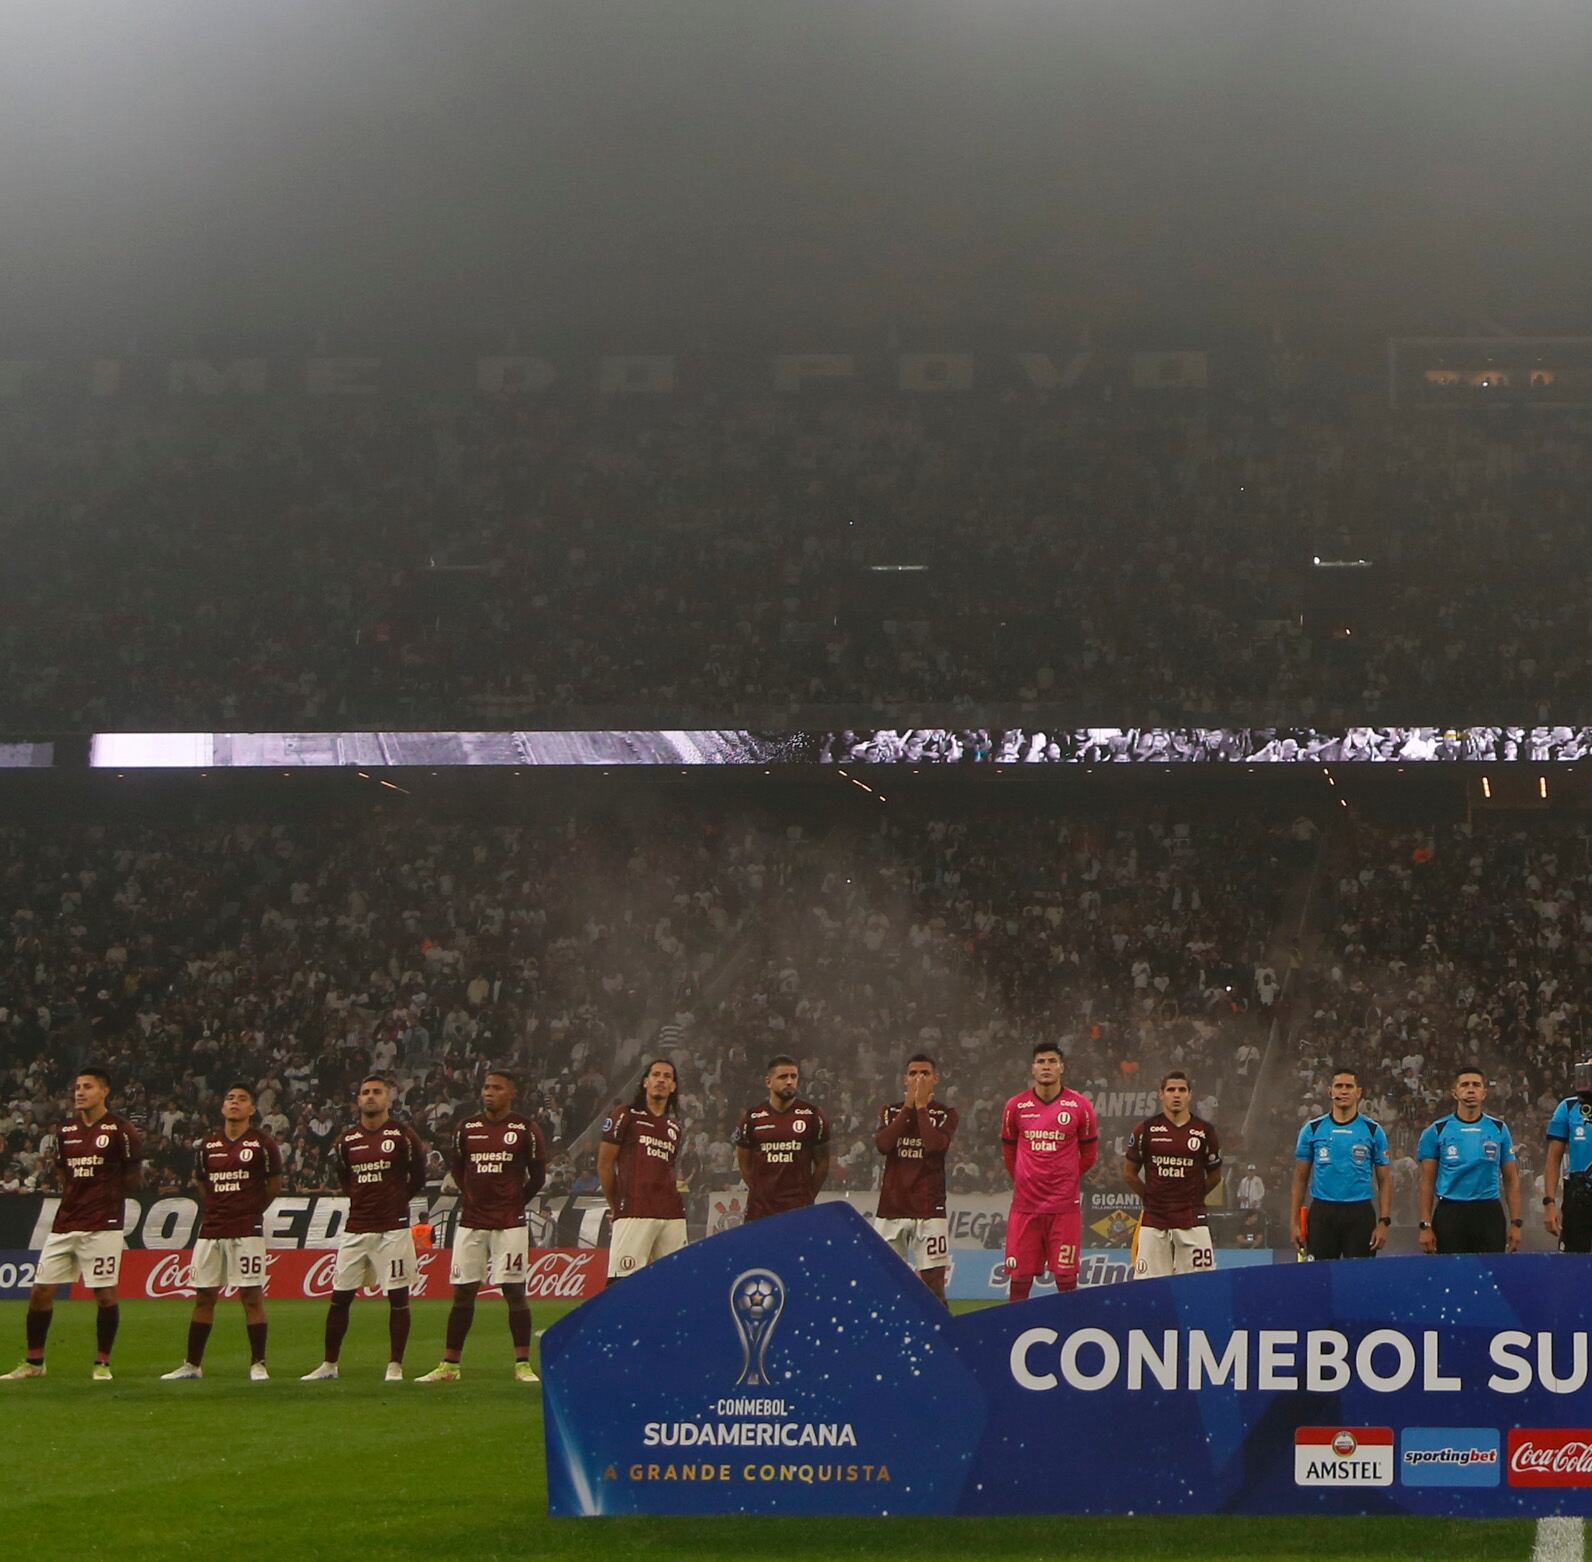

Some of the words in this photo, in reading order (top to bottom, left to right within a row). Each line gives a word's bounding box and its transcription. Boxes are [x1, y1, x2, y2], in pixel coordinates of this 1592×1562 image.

[646, 1145, 670, 1162] total
[760, 1139, 802, 1152] apuesta
[1031, 1140, 1057, 1151] total
[470, 1151, 513, 1164] apuesta
[767, 1152, 794, 1163] total
[1152, 1155, 1194, 1168] apuesta
[477, 1163, 503, 1173] total
[1157, 1166, 1185, 1178] total
[214, 1182, 241, 1192] total
[927, 1236, 947, 1255] 20
[1057, 1244, 1076, 1264] 21
[93, 1256, 116, 1276] 23
[240, 1255, 262, 1275] 36
[505, 1252, 523, 1272] 14
[1192, 1248, 1213, 1267] 29
[390, 1258, 404, 1278] 11
[1010, 1327, 1462, 1392] CONMEBOL
[643, 1422, 857, 1447] SUDAMERICANA
[1404, 1447, 1497, 1466] sportingbet
[604, 1465, 617, 1481] A
[629, 1464, 732, 1481] GRANDE
[743, 1464, 891, 1485] CONQUISTA
[1305, 1461, 1383, 1480] AMSTEL
